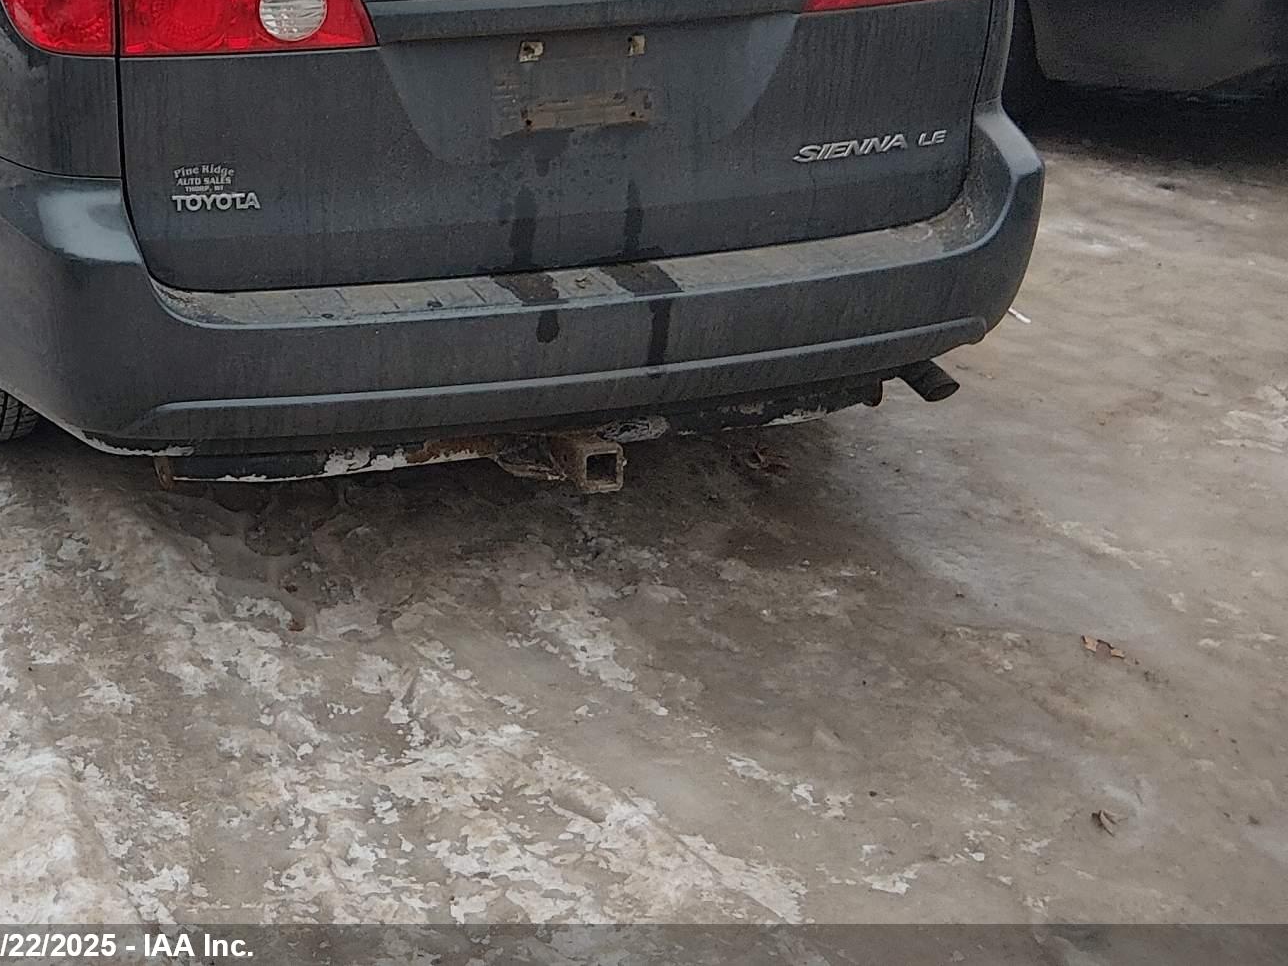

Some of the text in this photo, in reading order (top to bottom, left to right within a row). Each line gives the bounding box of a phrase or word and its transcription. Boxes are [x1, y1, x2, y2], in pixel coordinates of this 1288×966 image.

[792, 129, 947, 163] SIENNA LE
[173, 163, 235, 179] Pine Ridge
[176, 176, 232, 187] AUTO SALES
[172, 192, 261, 211] TOYOTA
